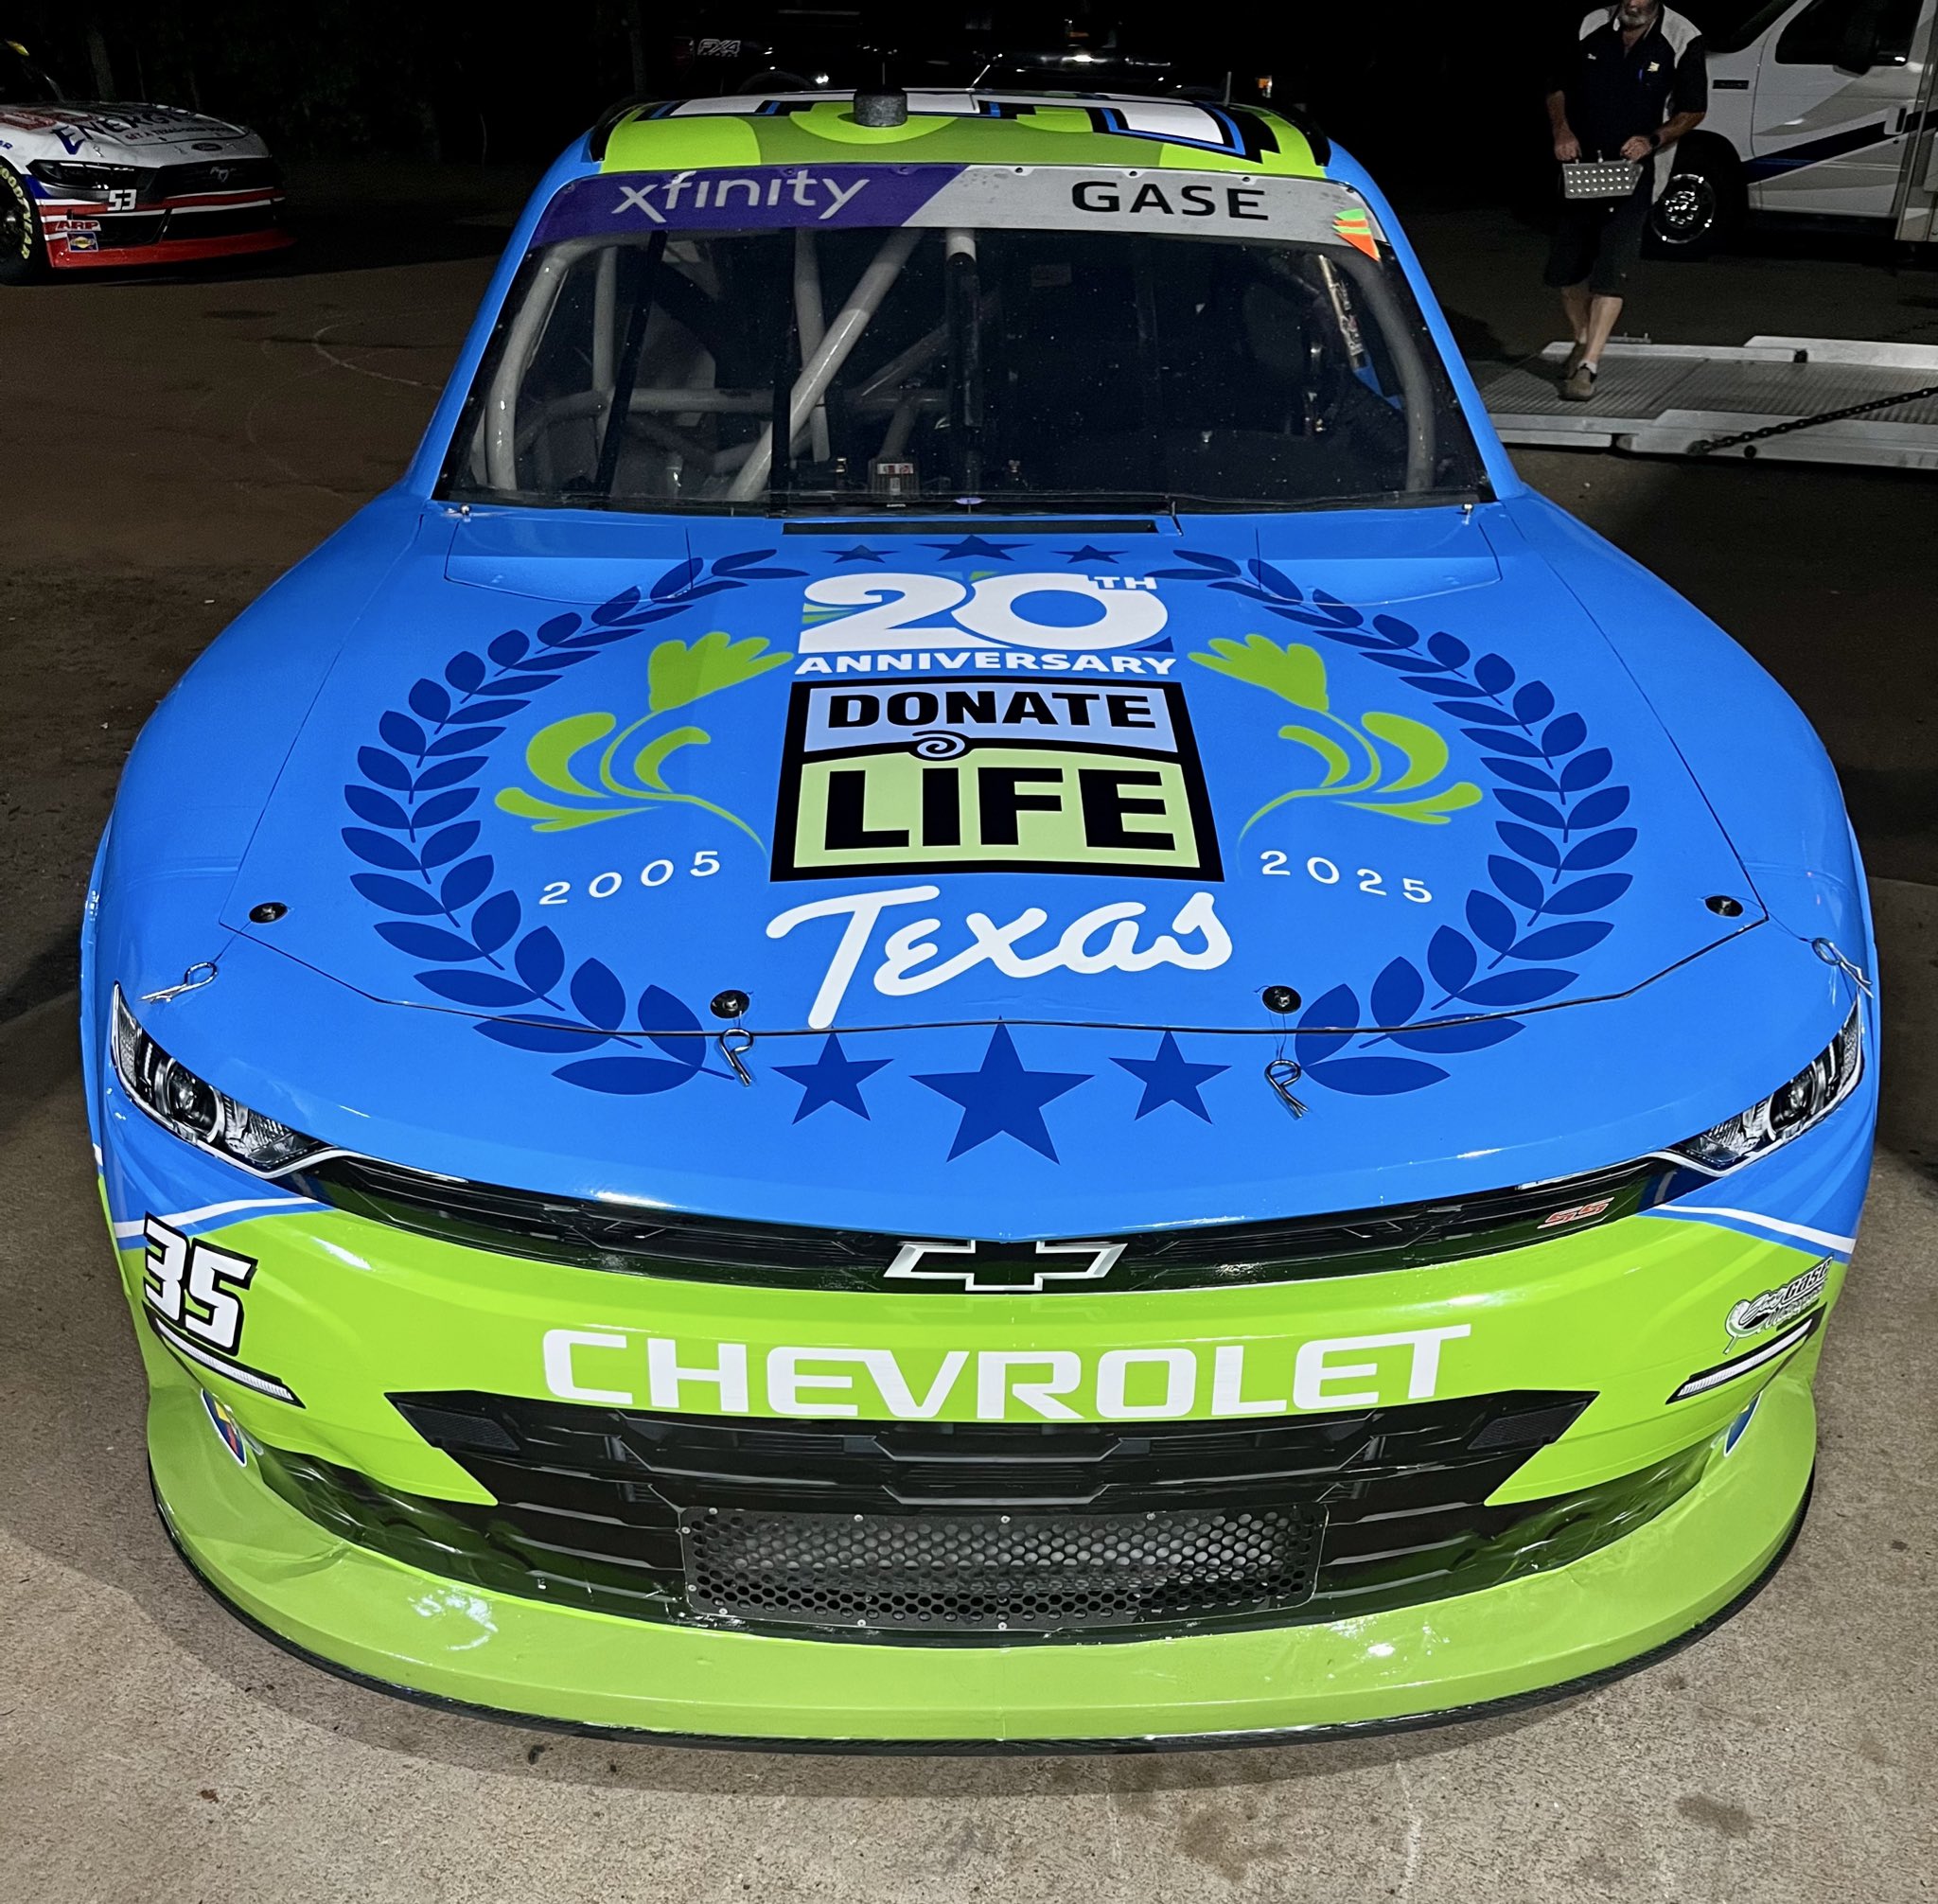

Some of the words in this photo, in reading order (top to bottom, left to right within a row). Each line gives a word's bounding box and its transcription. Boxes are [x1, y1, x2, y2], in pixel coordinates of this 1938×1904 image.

[0, 165, 33, 259] OODYEAR
[107, 189, 136, 211] 53
[612, 168, 868, 223] xfinity
[1070, 181, 1269, 220] GASE
[58, 220, 98, 230] ARP
[794, 652, 1177, 675] ANNIVERSARY
[828, 691, 1156, 729] DONATE
[824, 766, 1176, 852] LIFE
[537, 850, 722, 906] 2005
[1260, 849, 1434, 905] 2025
[766, 885, 1234, 1030] Texas
[144, 1213, 257, 1355] 35
[542, 1323, 1472, 1422] CHEVROLET
